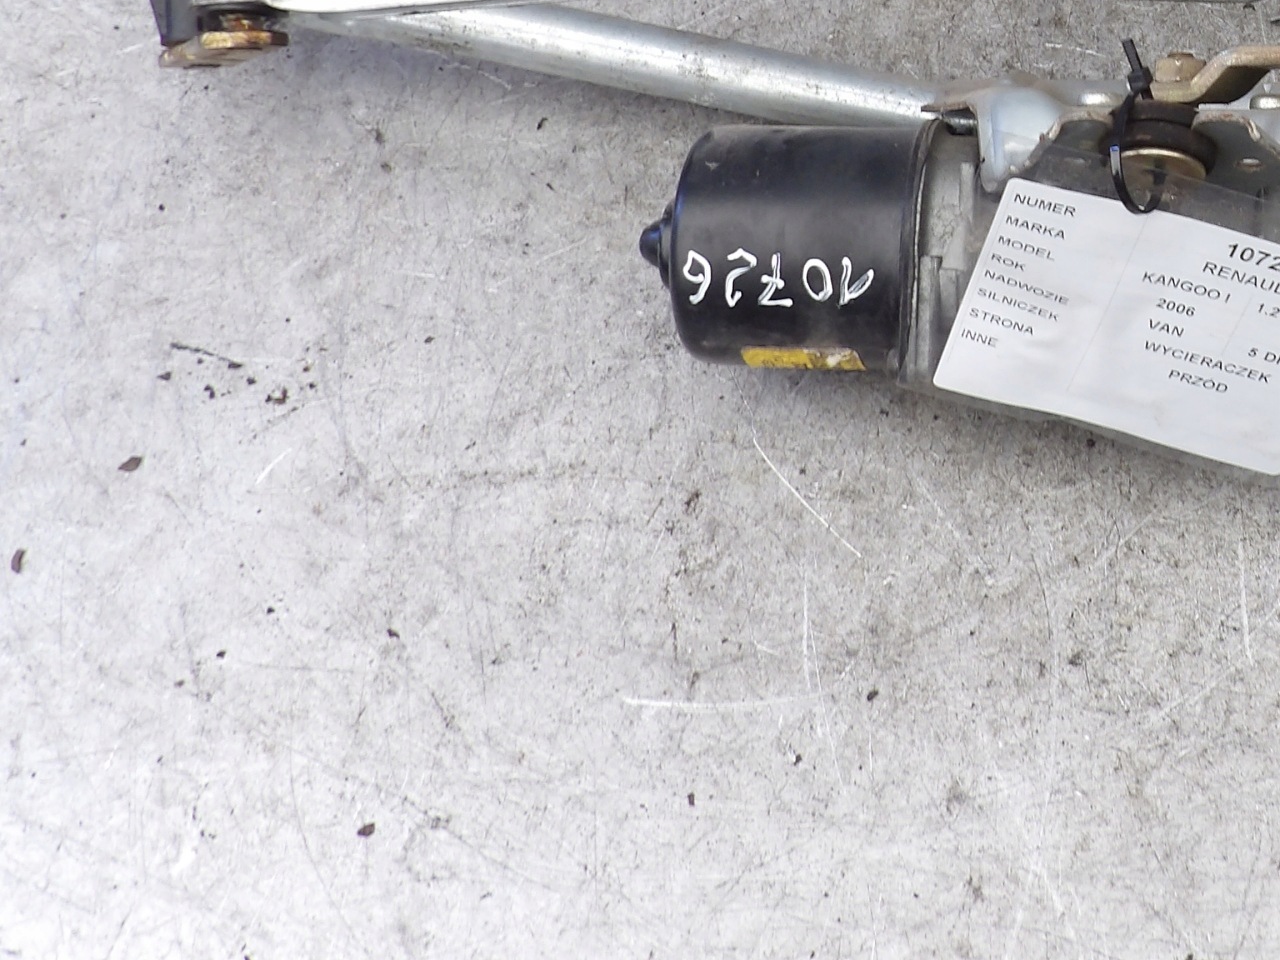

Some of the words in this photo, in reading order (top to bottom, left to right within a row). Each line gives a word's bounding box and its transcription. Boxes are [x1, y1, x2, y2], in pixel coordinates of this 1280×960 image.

[1013, 193, 1077, 218] NUMER
[1005, 214, 1066, 240] MARKA
[998, 235, 1055, 261] MODEL
[991, 253, 1026, 271] ROK
[683, 248, 874, 308] 10726
[984, 269, 1070, 305] NADWOZIE
[1142, 271, 1221, 300] KANGOO
[977, 288, 1059, 322] SILNICZEK
[1155, 298, 1196, 318] 2006
[1258, 303, 1280, 318] 1.2
[969, 307, 1034, 336] STRONA
[1149, 318, 1185, 338] VAN
[961, 328, 999, 348] INNE
[1144, 340, 1273, 384] WYCIERACZEK
[1247, 347, 1257, 358] 5
